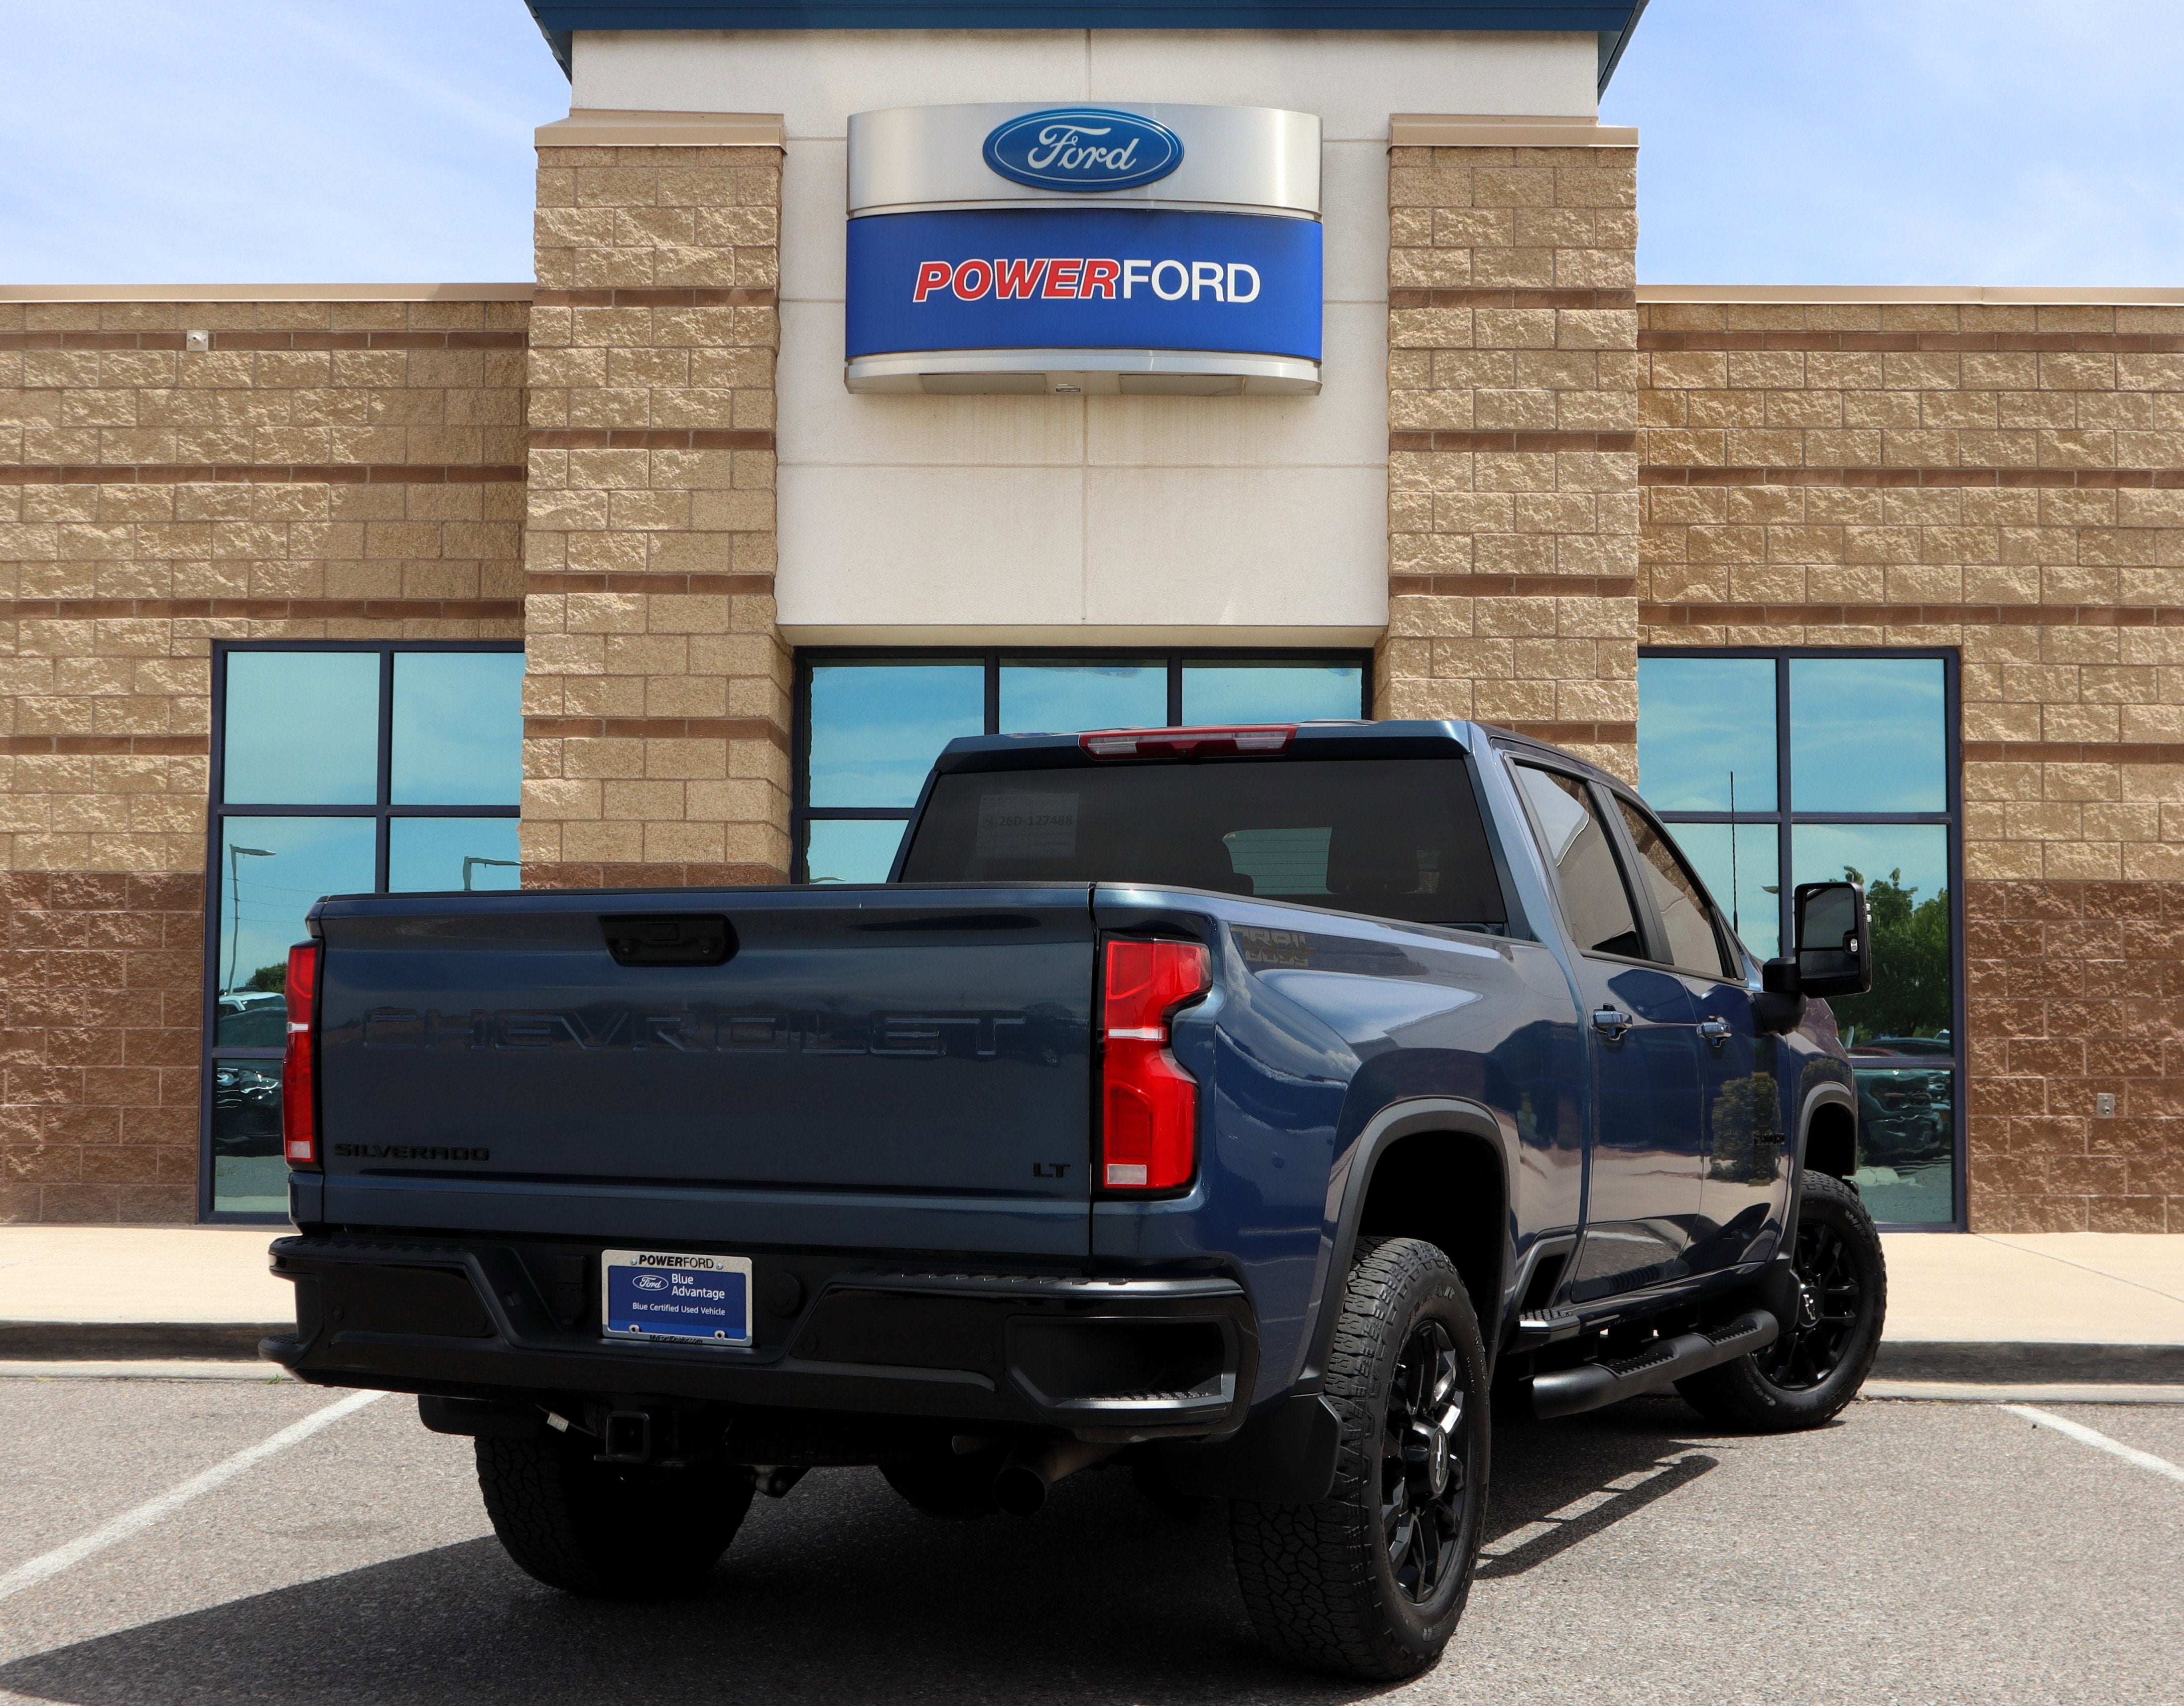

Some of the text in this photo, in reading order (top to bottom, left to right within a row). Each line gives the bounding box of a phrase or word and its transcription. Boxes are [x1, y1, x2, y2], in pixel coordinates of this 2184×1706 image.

[1027, 124, 1139, 171] Ford
[913, 258, 1261, 303] POWERFORD
[362, 1009, 1027, 1056] CHEVROLET
[334, 1143, 490, 1161] SILVERADO
[1033, 1162, 1071, 1178] LT
[638, 1255, 714, 1269] POWERFORD
[639, 1276, 663, 1288] Ford
[672, 1273, 694, 1284] Blue
[671, 1285, 725, 1300] Advantage
[632, 1302, 726, 1316] Blue Certified Used Vehicle
